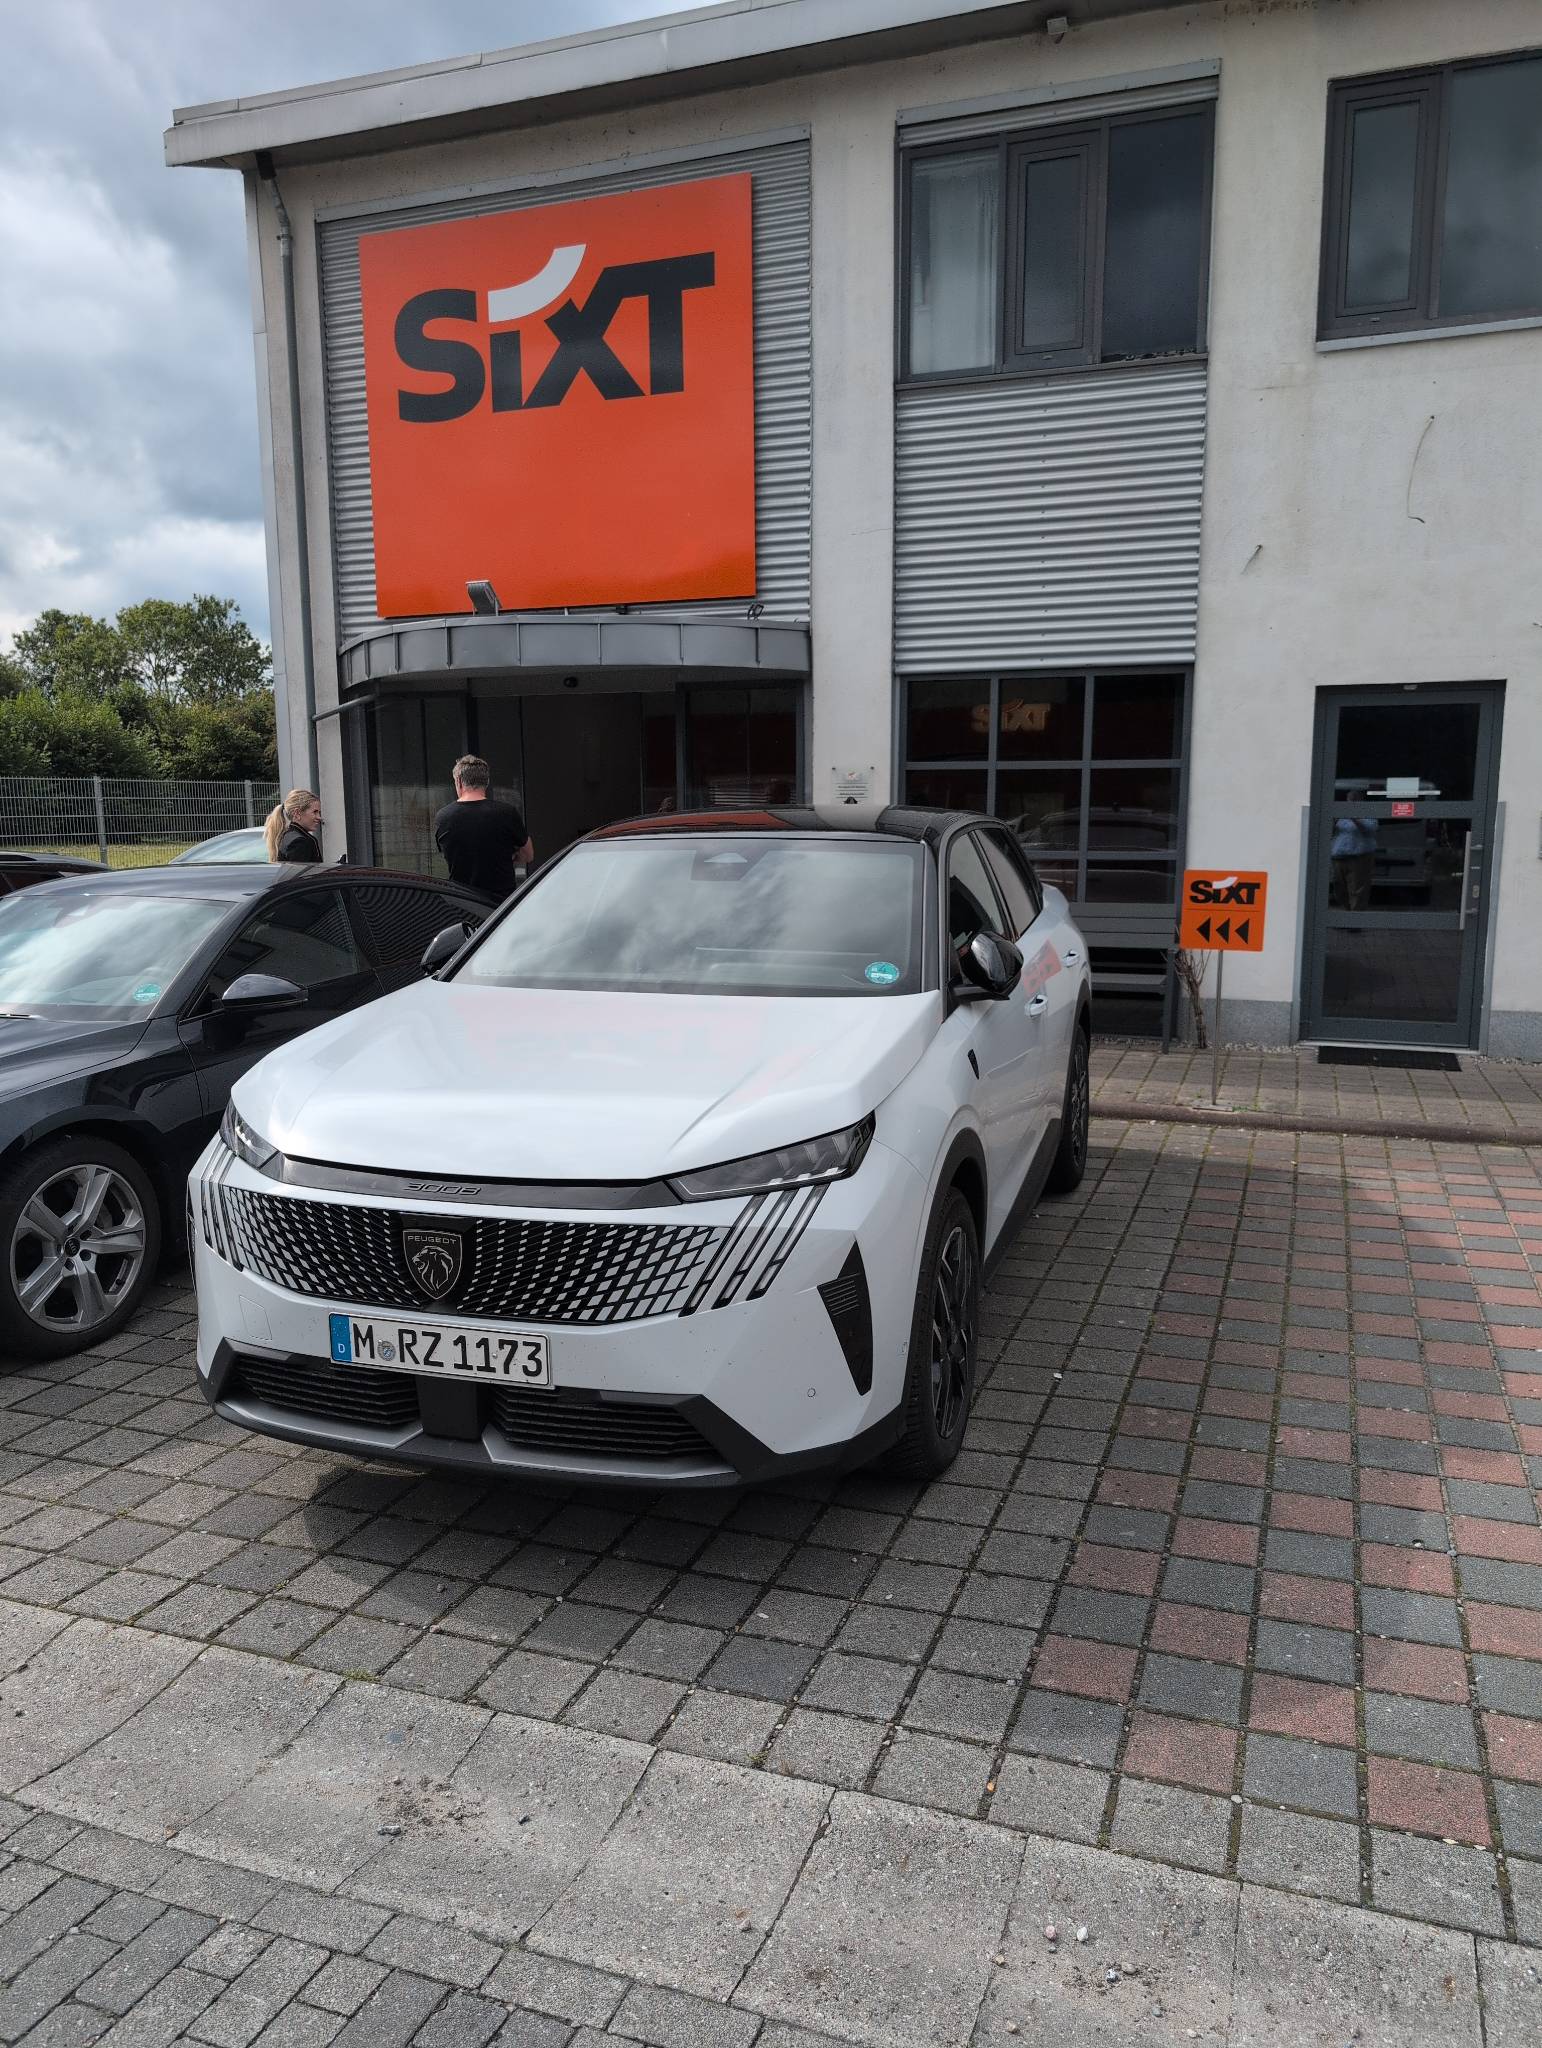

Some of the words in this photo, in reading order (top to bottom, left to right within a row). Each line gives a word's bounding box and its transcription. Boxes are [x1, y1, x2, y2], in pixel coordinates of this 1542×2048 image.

[404, 1182, 482, 1196] 3008
[407, 1235, 457, 1245] PEUGEOT
[338, 1343, 345, 1354] D
[353, 1322, 375, 1360] M
[398, 1328, 444, 1368] RZ
[453, 1334, 543, 1378] 1173
